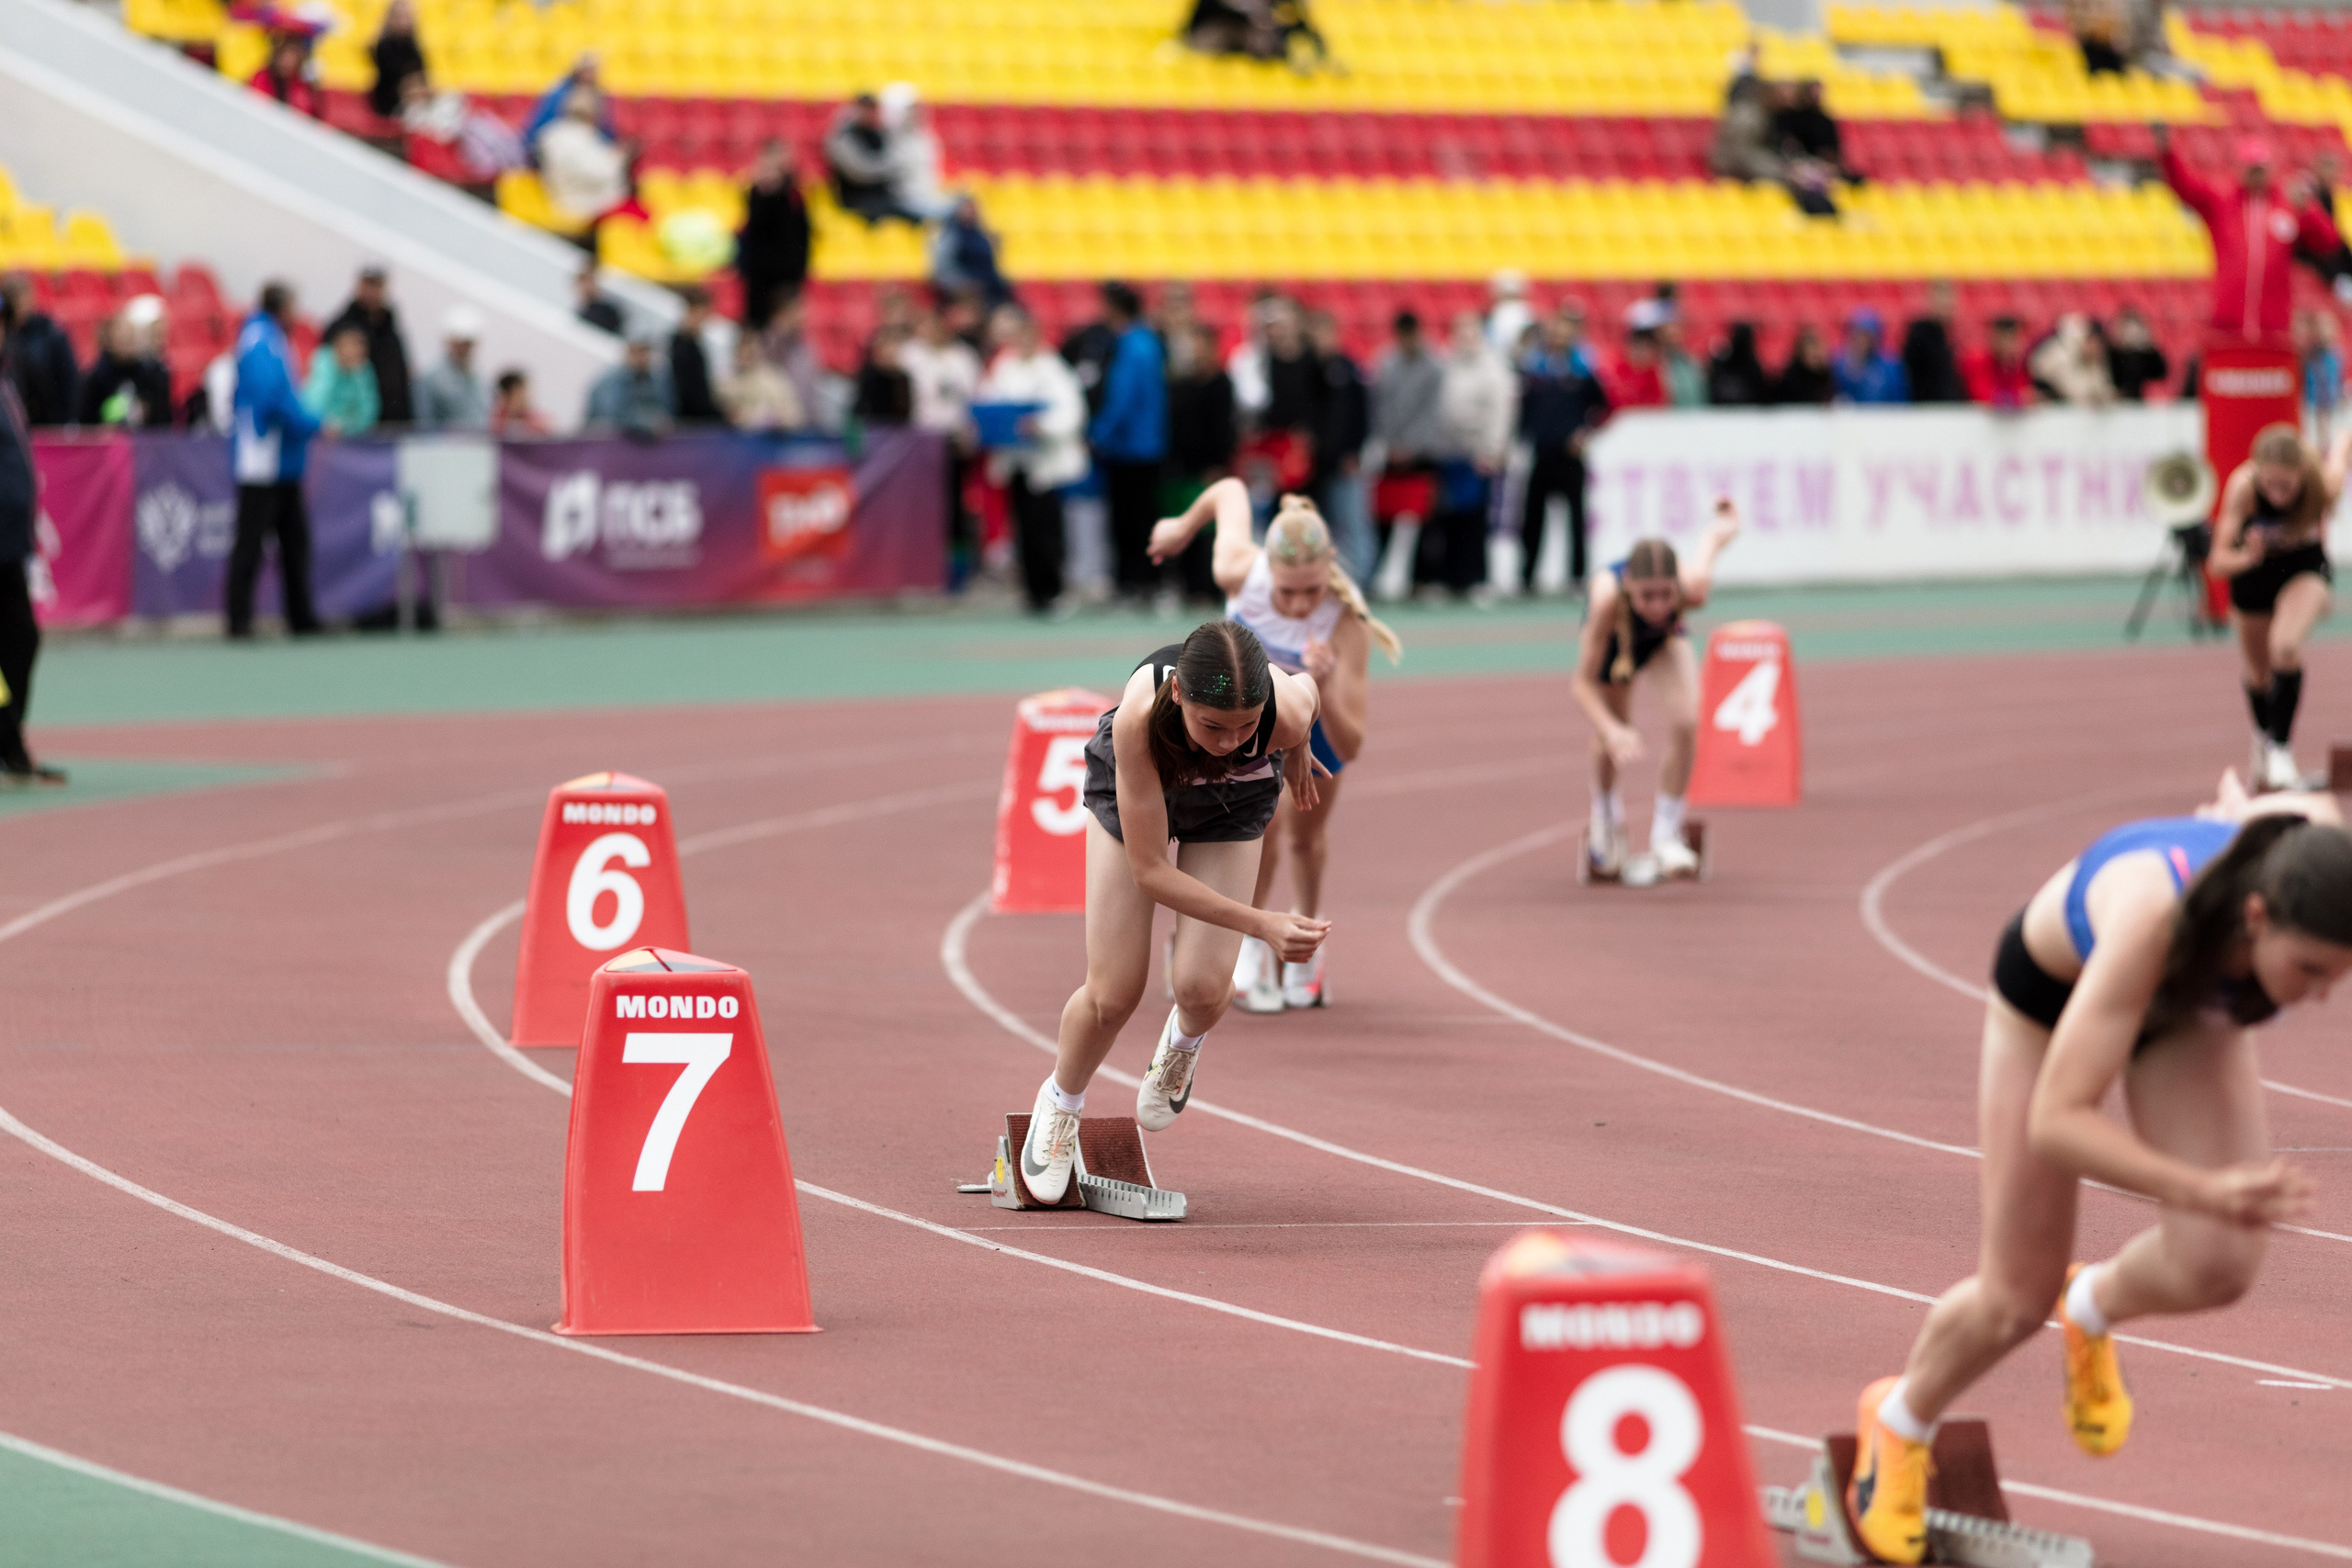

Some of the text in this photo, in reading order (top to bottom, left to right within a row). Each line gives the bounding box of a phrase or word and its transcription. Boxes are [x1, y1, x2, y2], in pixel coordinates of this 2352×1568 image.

[1714, 661, 1779, 745] 4
[562, 803, 656, 825] MONDO
[1031, 736, 1086, 835] 5
[566, 832, 650, 951] 6
[616, 996, 739, 1019] MONDO
[622, 1032, 733, 1191] 7
[1521, 1303, 1703, 1349] MONDO
[1547, 1364, 1702, 1568] 8
